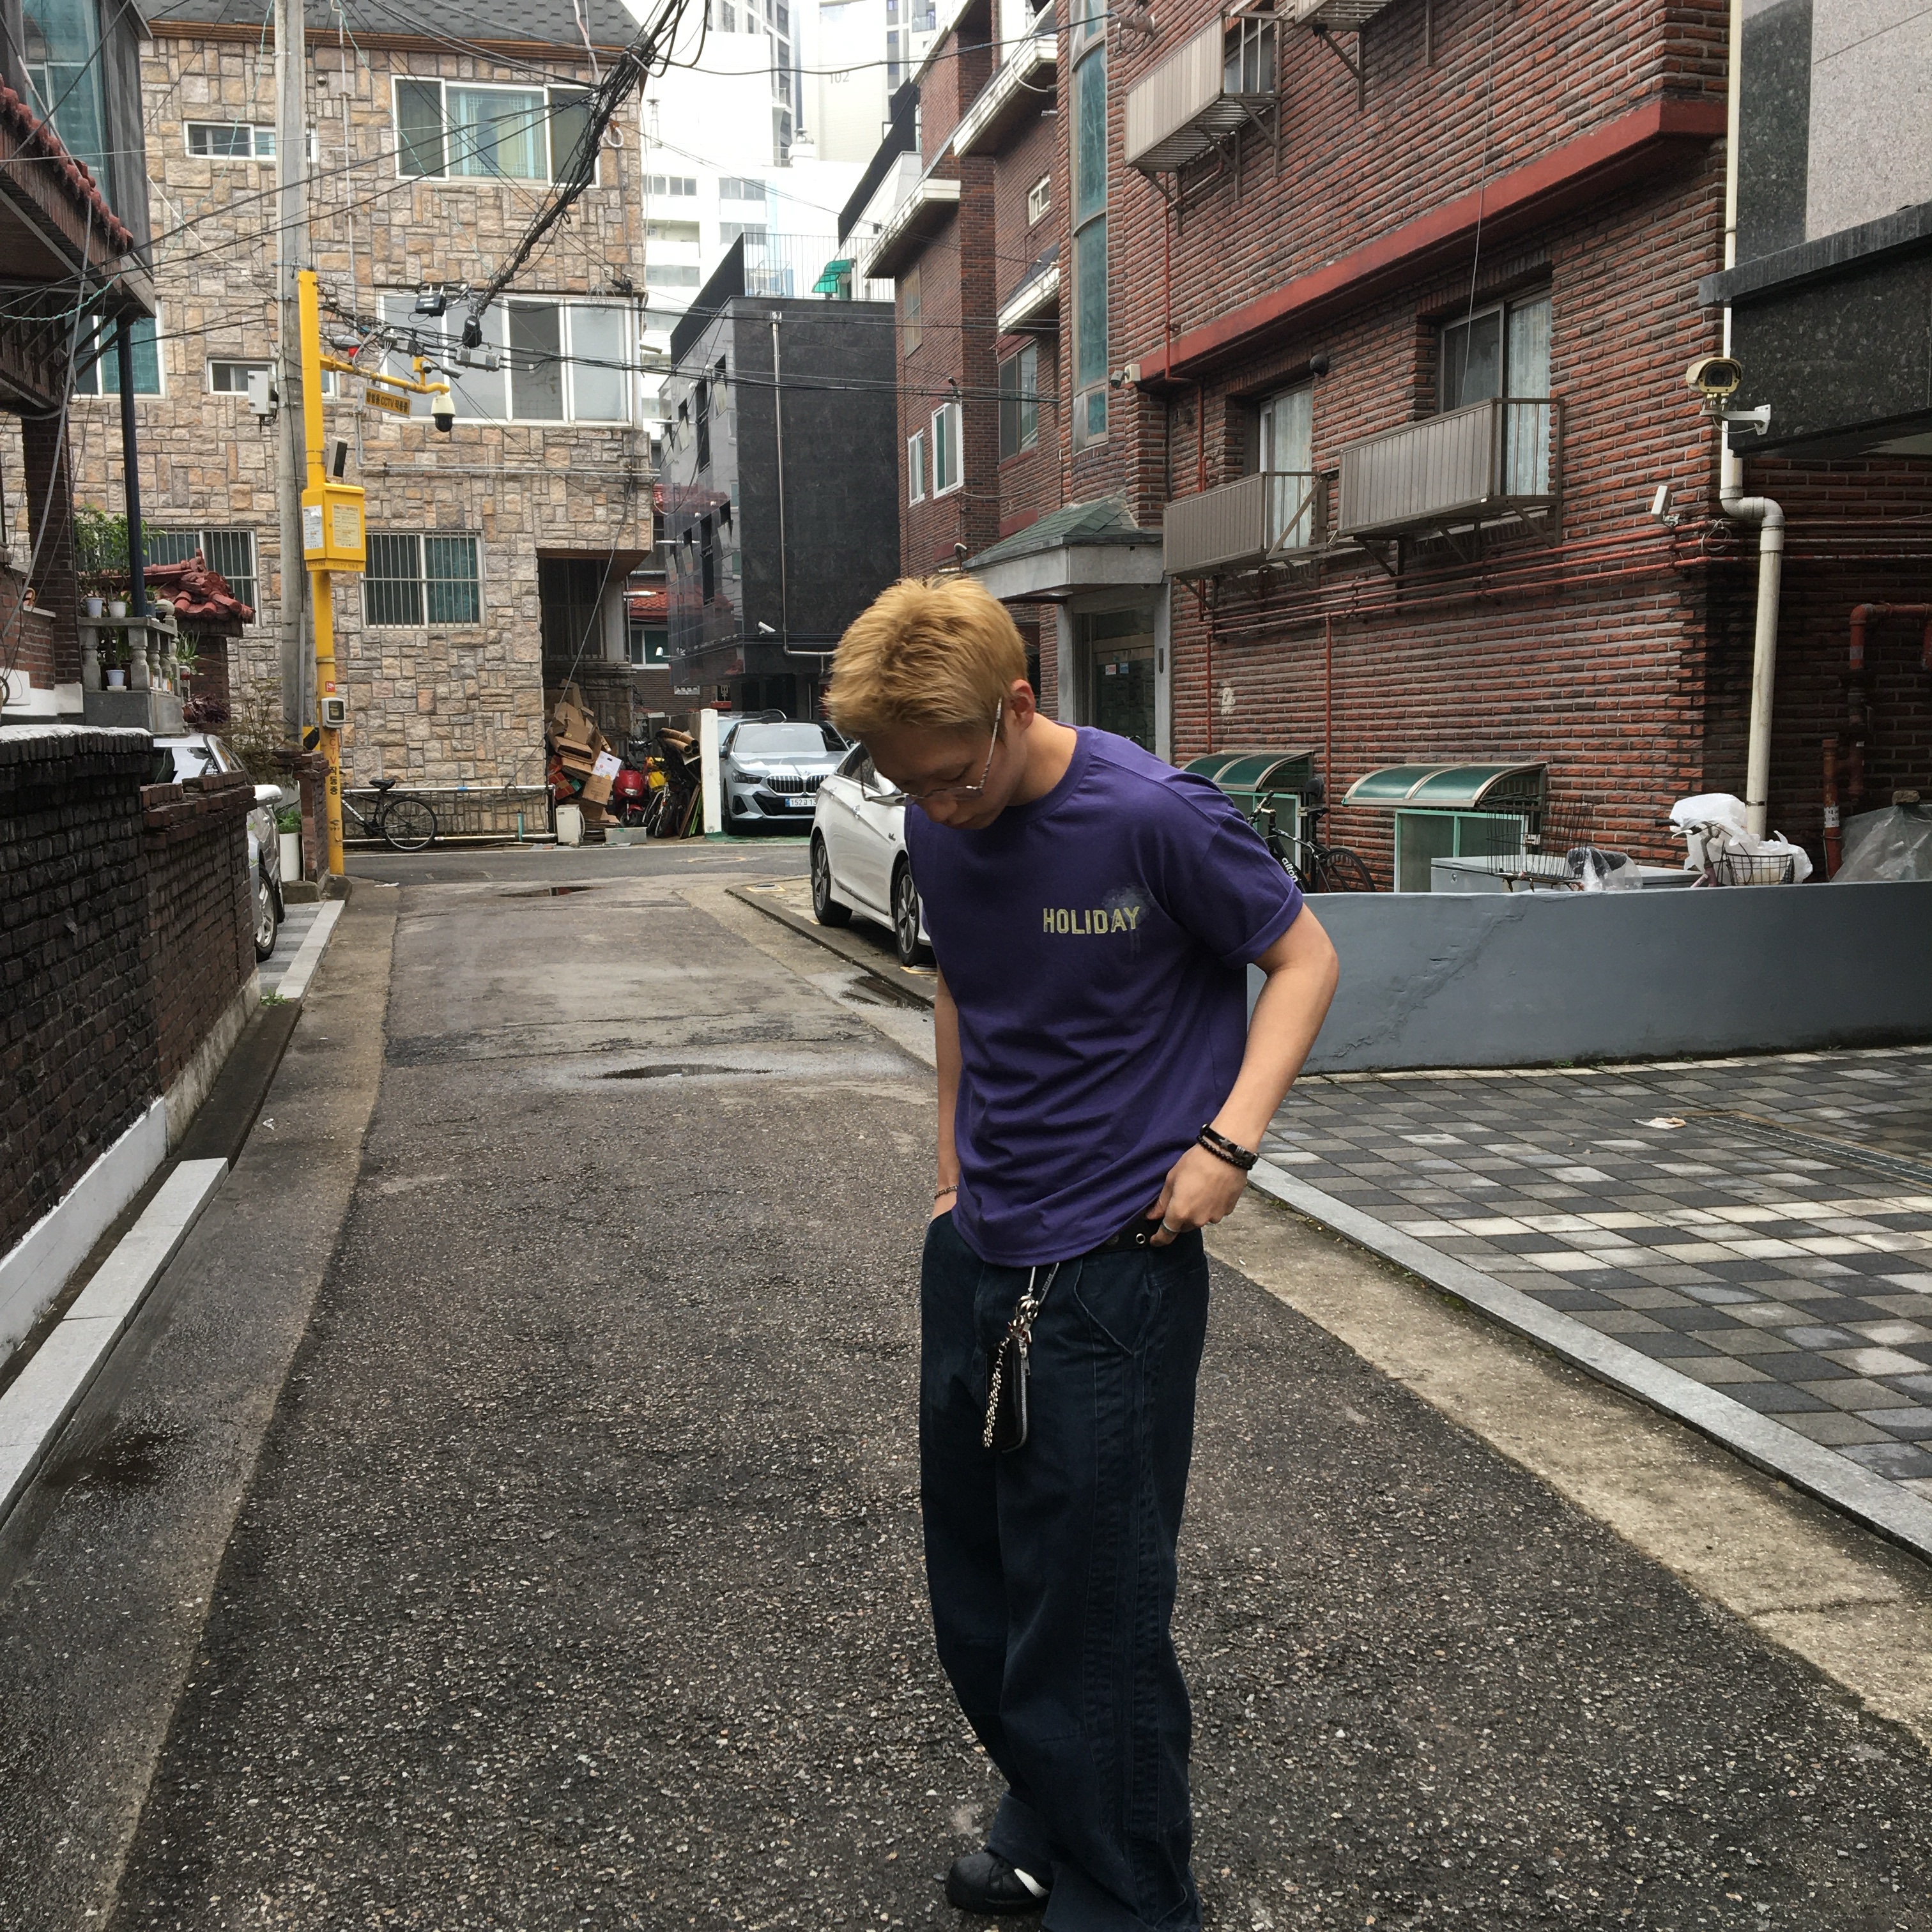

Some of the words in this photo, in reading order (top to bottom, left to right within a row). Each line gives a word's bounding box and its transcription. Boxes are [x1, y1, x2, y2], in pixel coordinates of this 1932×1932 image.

[831, 71, 849, 84] 102
[381, 396, 394, 408] CCTV
[395, 399, 408, 413] 작동중
[1282, 857, 1299, 883] alton
[1043, 906, 1140, 934] HOLIDAY
